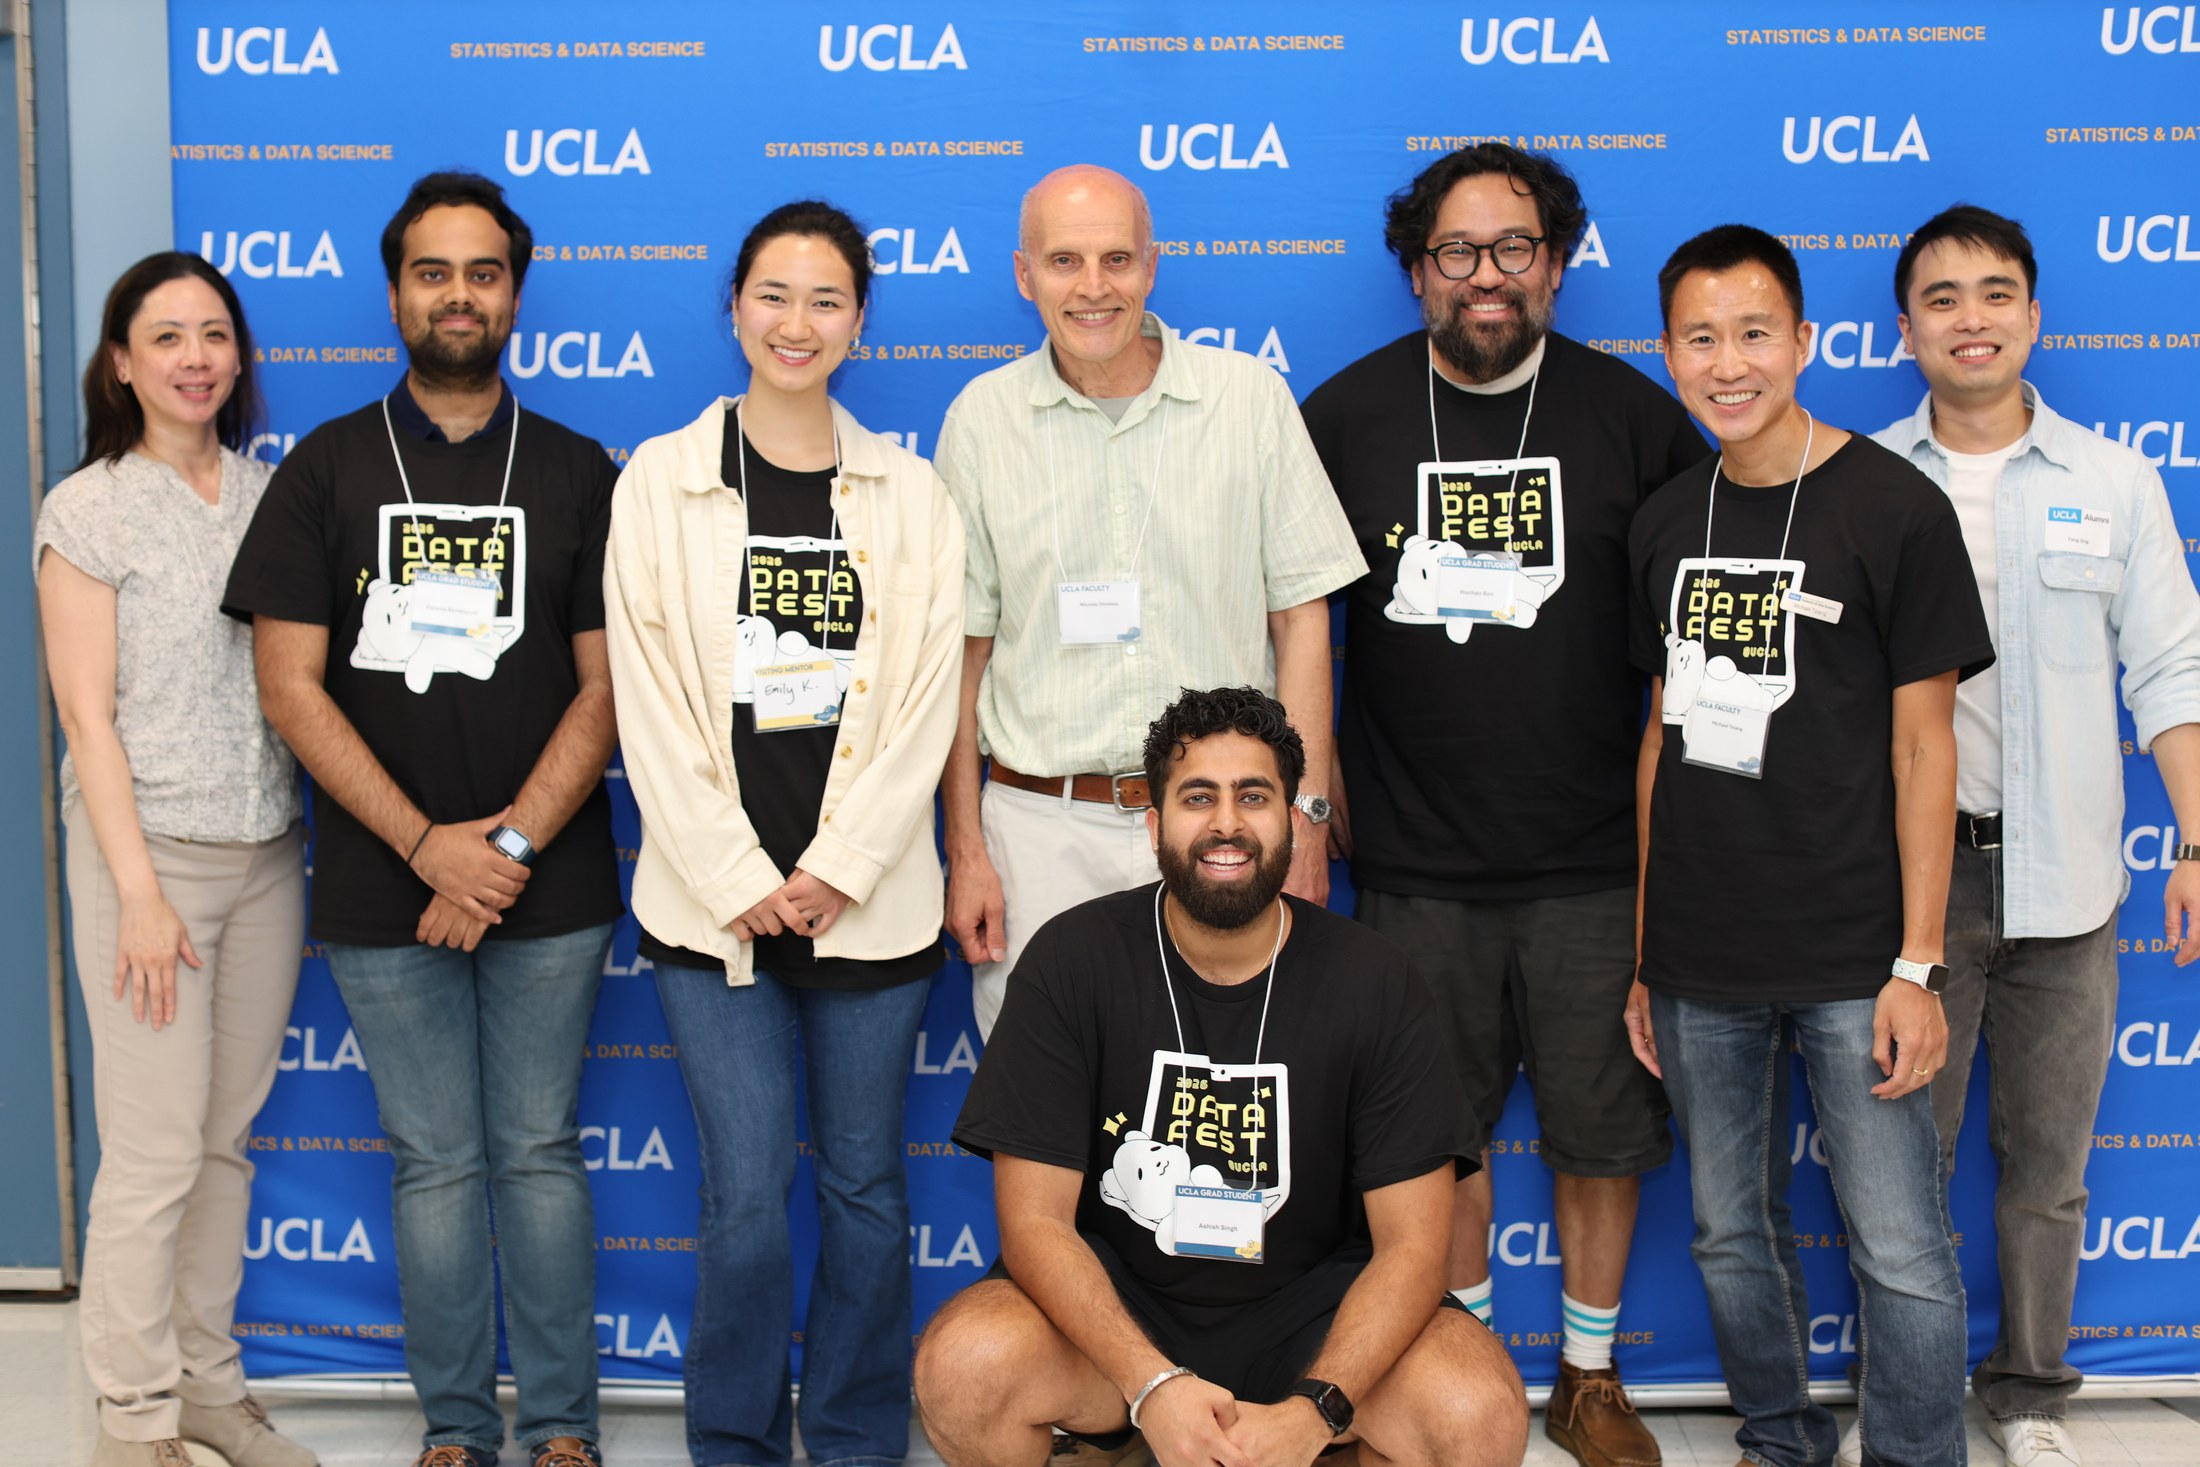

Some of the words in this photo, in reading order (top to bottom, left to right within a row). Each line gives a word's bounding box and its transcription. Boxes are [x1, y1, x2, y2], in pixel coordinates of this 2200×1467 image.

[1460, 15, 1611, 65] UCLA
[1726, 28, 1832, 46] STATISTICS
[1835, 28, 1849, 44] &
[1853, 27, 1903, 44] DATA
[1906, 25, 1986, 43] SCIENCE
[2100, 5, 2200, 56] UCL
[196, 26, 340, 75] UCLA
[450, 42, 554, 59] STATISTICS
[556, 42, 570, 59] &
[573, 41, 624, 58] DATA
[626, 40, 706, 58] SCIENCE
[818, 22, 968, 72] UCLA
[1082, 36, 1189, 53] STATISTICS
[1192, 36, 1206, 52] &
[1210, 35, 1261, 52] DATA
[1264, 34, 1345, 52] SCIENCE
[1516, 135, 1529, 150] &
[1533, 134, 1584, 151] DATA
[1587, 133, 1667, 150] SCIENCE
[1782, 113, 1931, 164] UCLA
[2045, 126, 2150, 144] STATISTICS
[2153, 126, 2166, 142] &
[2170, 125, 2200, 142] DA
[170, 144, 246, 161] ATISTICS
[248, 144, 262, 161] &
[264, 144, 314, 161] DATA
[316, 144, 394, 161] SCIENCE
[504, 127, 652, 177] UCLA
[764, 141, 870, 158] STATISTICS
[872, 141, 887, 157] &
[890, 141, 941, 157] DATA
[943, 140, 1024, 157] SCIENCE
[1139, 121, 1290, 171] UCLA
[1194, 240, 1208, 256] &
[1212, 239, 1263, 256] DATA
[1265, 239, 1346, 255] SCIENCE
[1779, 233, 1831, 250] STICS
[1834, 234, 1848, 250] &
[1852, 233, 1902, 250] DATA
[2096, 214, 2200, 263] UCL
[200, 230, 344, 279] UCLA
[559, 245, 573, 261] &
[577, 245, 627, 261] DATA
[629, 244, 709, 261] SCIENCE
[866, 226, 970, 275] CLA
[1587, 338, 1665, 354] SCIENCE
[1805, 320, 1917, 370] CL
[2042, 333, 2145, 350] STATISTICS
[2148, 333, 2161, 349] &
[2165, 333, 2200, 349] DAT
[269, 347, 318, 363] DATA
[320, 346, 397, 363] SCIENCE
[508, 330, 655, 379] UCLA
[876, 345, 889, 361] &
[893, 344, 944, 360] DATA
[946, 343, 1026, 360] SCIENCE
[1442, 481, 1472, 492] 2026
[1441, 489, 1542, 516] DATA
[1441, 513, 1542, 540] FEST
[2053, 510, 2078, 521] UCLA
[2084, 513, 2110, 524] Alumni
[402, 536, 505, 561] DATA
[751, 555, 783, 567] 2026
[1441, 558, 1460, 566] UCLA
[1461, 560, 1482, 568] GRAD
[751, 568, 854, 593] DATA
[1061, 585, 1080, 593] UCLA
[1081, 584, 1110, 593] FACULTY
[750, 592, 854, 617] FEST
[1688, 591, 1780, 617] DATA
[1686, 616, 1778, 642] FEST
[1743, 646, 1778, 658] @UCA
[785, 663, 814, 673] MENTOR
[765, 683, 795, 705] Emily
[1696, 700, 1713, 709] UCLA
[1714, 704, 1741, 715] FACULTY
[2123, 825, 2178, 872] CL
[276, 1026, 368, 1071] CLA
[597, 1044, 645, 1059] DATA
[914, 1029, 979, 1075] LA
[2110, 1021, 2200, 1067] CL
[1176, 1076, 1209, 1090] 2026
[1171, 1091, 1266, 1128] DATA
[281, 1136, 295, 1152] &
[297, 1136, 346, 1152] DATA
[347, 1137, 391, 1153] SCIE
[1167, 1120, 1266, 1156] FEST
[1511, 1139, 1524, 1154] &
[2129, 1134, 2142, 1149] &
[2146, 1133, 2194, 1149] DATA
[579, 1125, 674, 1171] CLA
[907, 1142, 956, 1157] DATA
[1178, 1187, 1199, 1197] UCLA
[1200, 1189, 1222, 1199] GRAD
[1223, 1190, 1257, 1201] STUDENT
[1198, 1222, 1220, 1231] Ashish
[1220, 1223, 1238, 1233] Singh
[243, 1217, 376, 1263] UCLA
[603, 1236, 652, 1251] DATA
[654, 1236, 697, 1252] SCIE
[910, 1224, 985, 1268] LA
[1488, 1223, 1562, 1267] CL
[307, 1324, 354, 1338] DATA
[356, 1323, 405, 1339] SCIEN
[1510, 1332, 1522, 1346] &
[1526, 1332, 1562, 1347] DAT
[1612, 1331, 1655, 1346] ENCE
[2068, 1325, 2119, 1340] STICS
[2122, 1325, 2135, 1338] &
[2139, 1324, 2189, 1339] DATA
